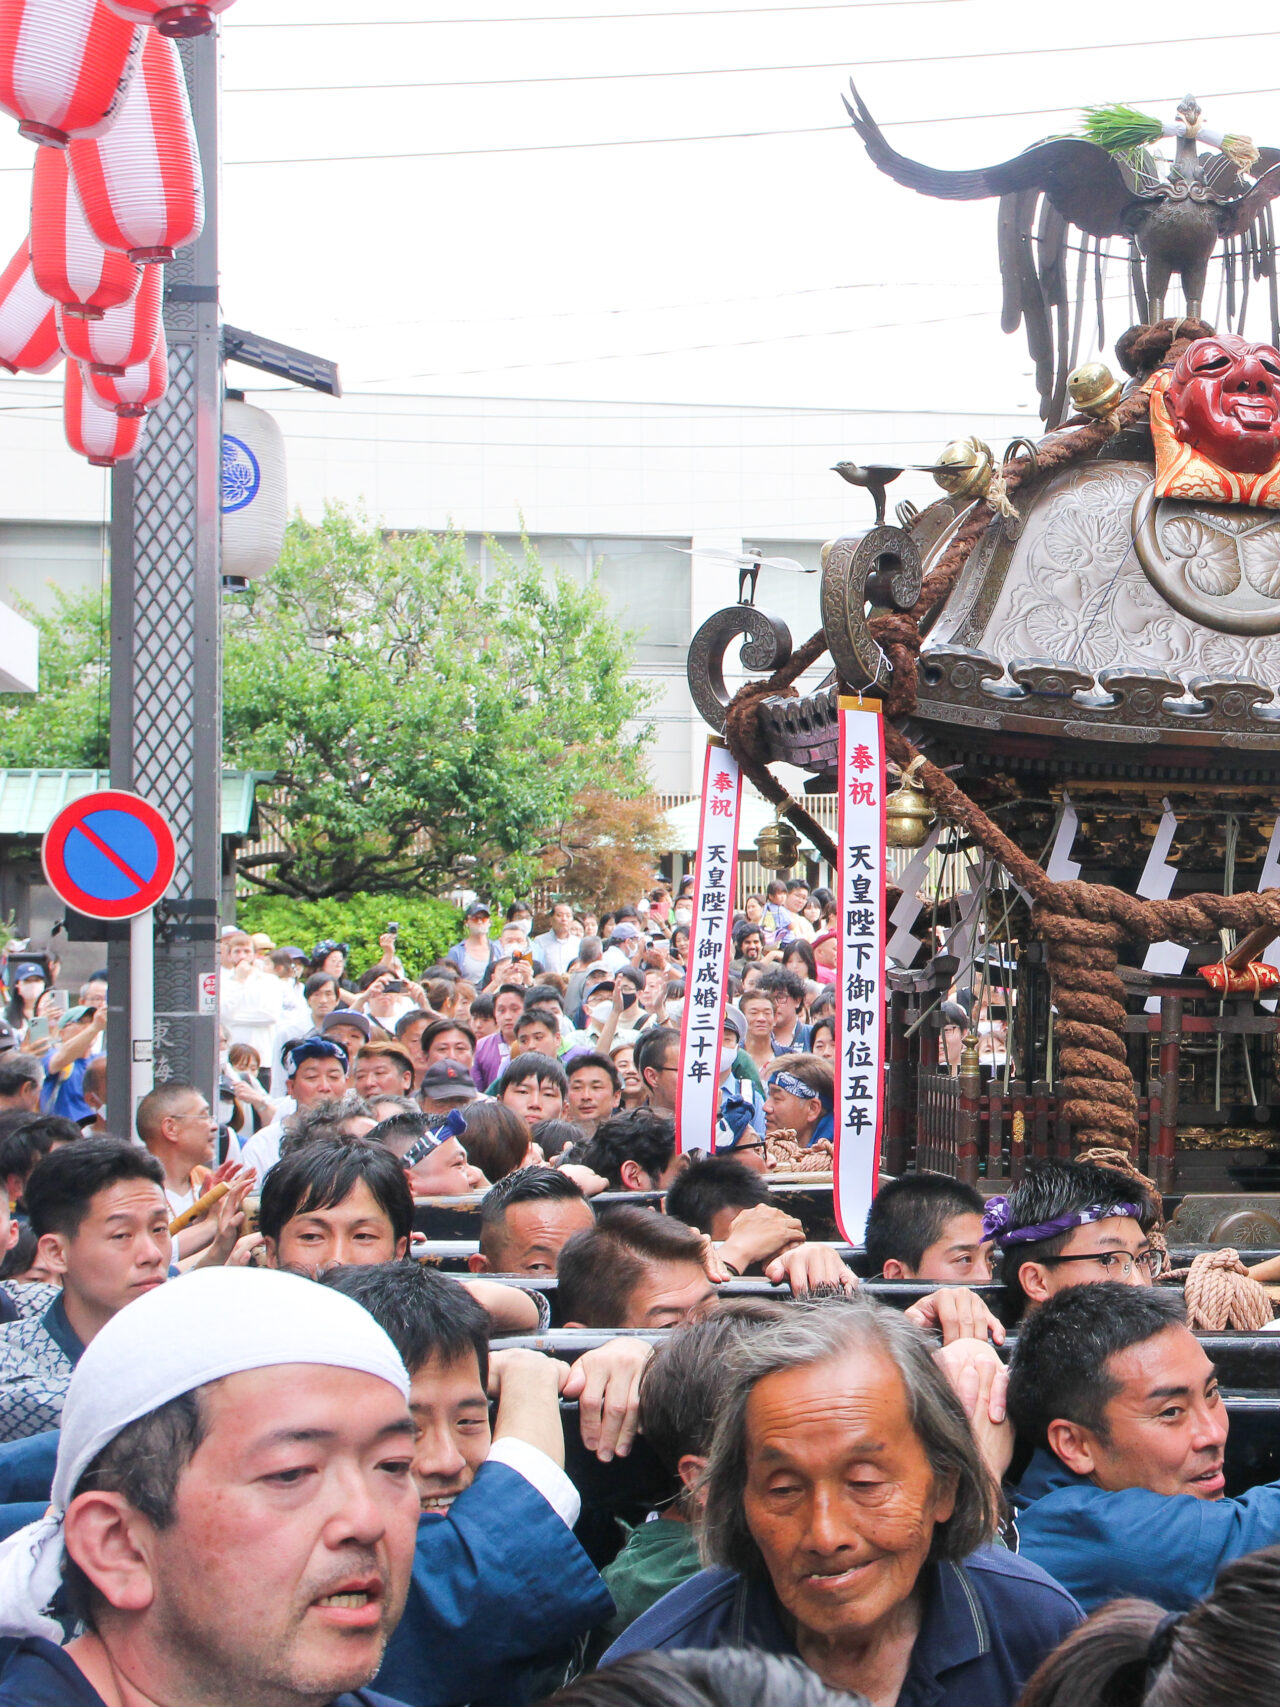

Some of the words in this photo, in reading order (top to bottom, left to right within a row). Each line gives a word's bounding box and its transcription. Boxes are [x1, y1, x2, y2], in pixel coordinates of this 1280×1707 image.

[709, 771, 734, 818] 奉祝
[848, 744, 876, 806] 奉祝
[687, 845, 728, 1083] 天皇陛下御成婚三十年
[844, 845, 875, 1135] 天皇陛下御即位五年
